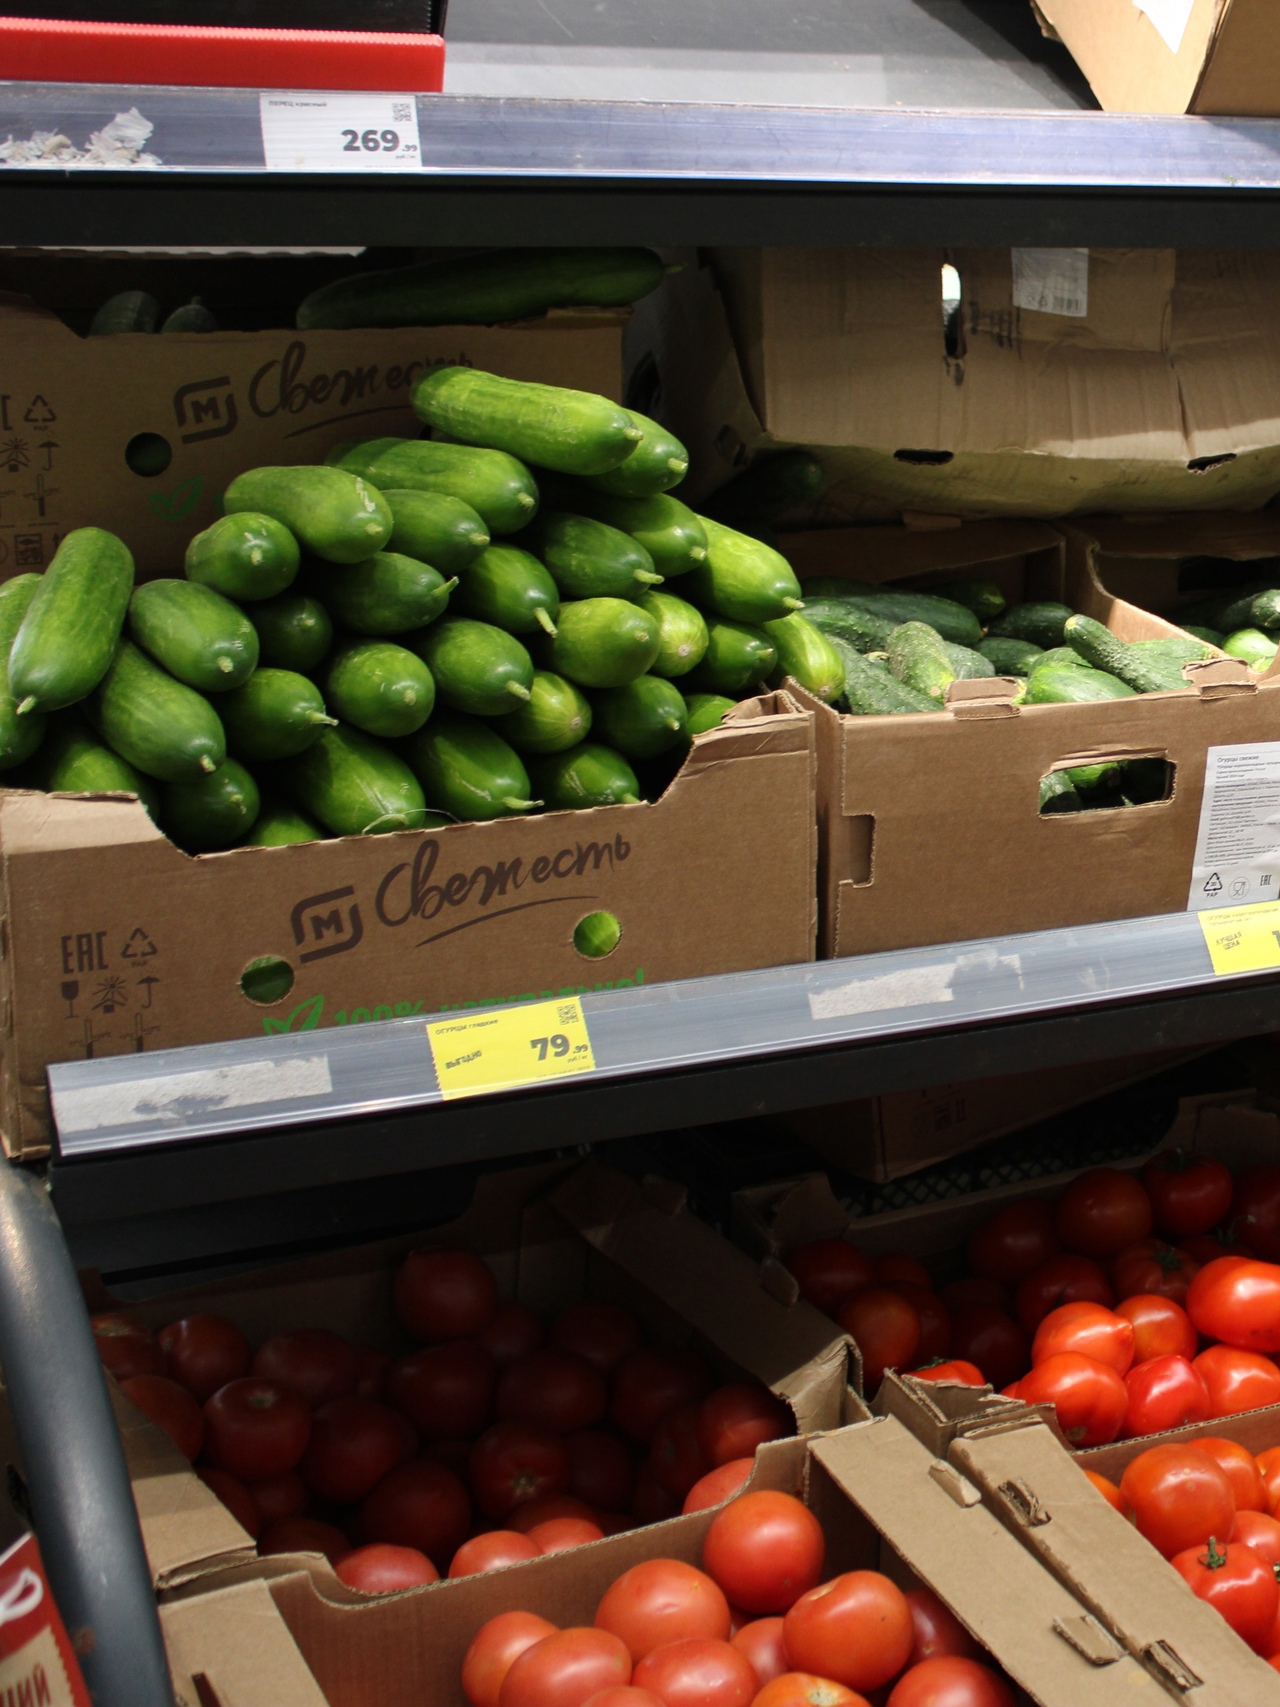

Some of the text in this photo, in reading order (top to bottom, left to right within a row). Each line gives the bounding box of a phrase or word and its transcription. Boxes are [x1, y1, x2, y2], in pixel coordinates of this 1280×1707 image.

[341, 129, 400, 152] 269
[435, 1023, 467, 1035] ОГУРЦЫ
[530, 1034, 570, 1062] 79
